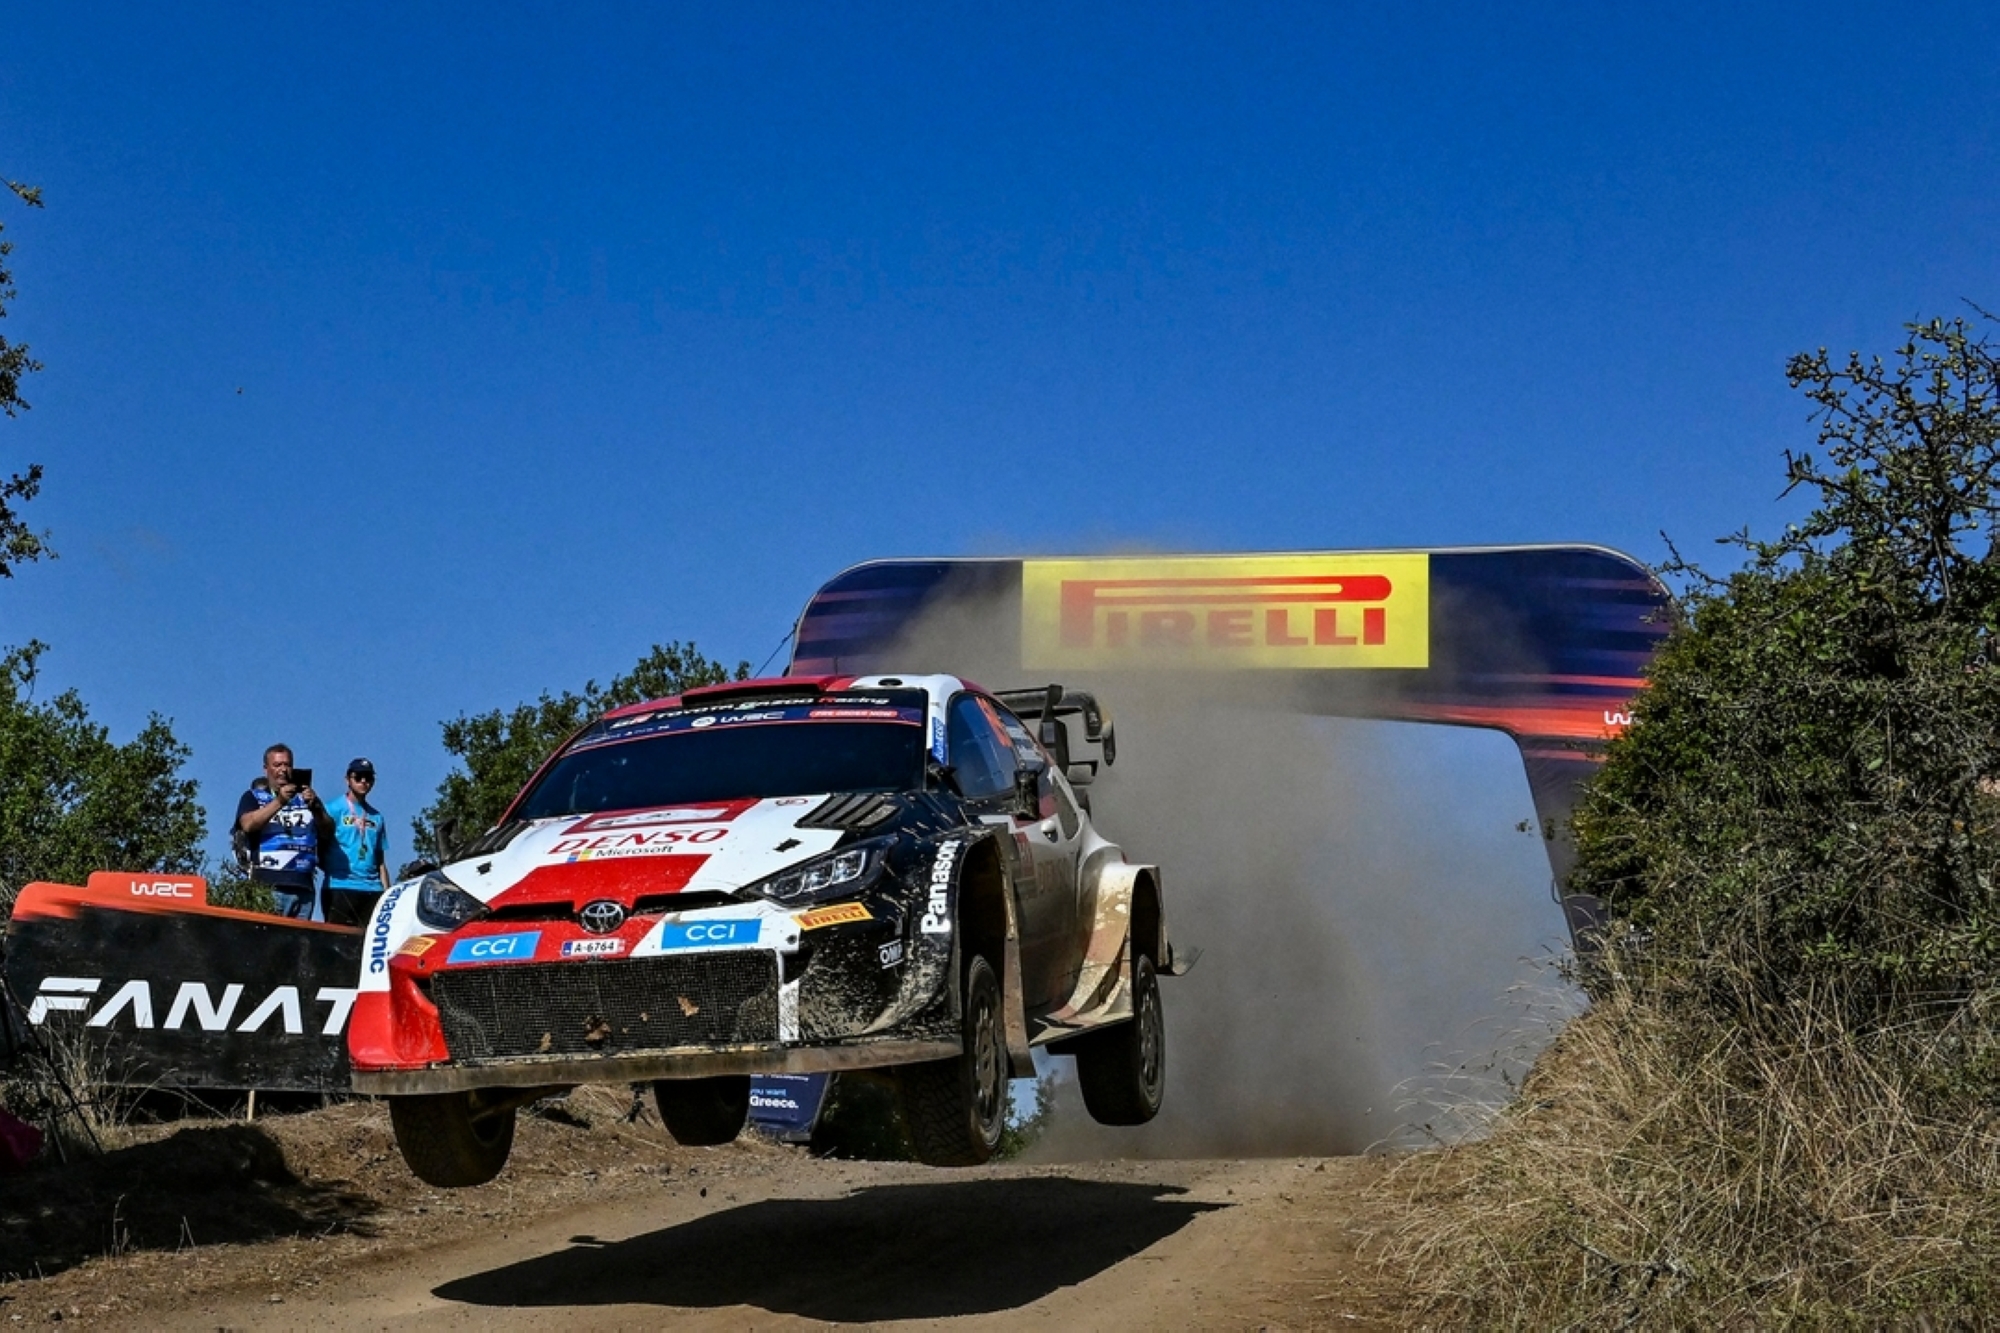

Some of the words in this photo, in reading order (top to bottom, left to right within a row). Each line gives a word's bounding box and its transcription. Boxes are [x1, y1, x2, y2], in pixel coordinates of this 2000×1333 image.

[1060, 575, 1392, 647] PIRELLI
[720, 710, 786, 723] WRC
[548, 828, 730, 855] DENSO
[595, 845, 674, 858] Microsoft
[131, 881, 194, 898] WRC
[799, 904, 866, 927] PIRELLI
[685, 923, 737, 942] CCI
[470, 937, 517, 957] CCI
[574, 941, 615, 953] A-6764
[27, 977, 361, 1035] FANAT
[749, 1095, 799, 1109] Greece.
